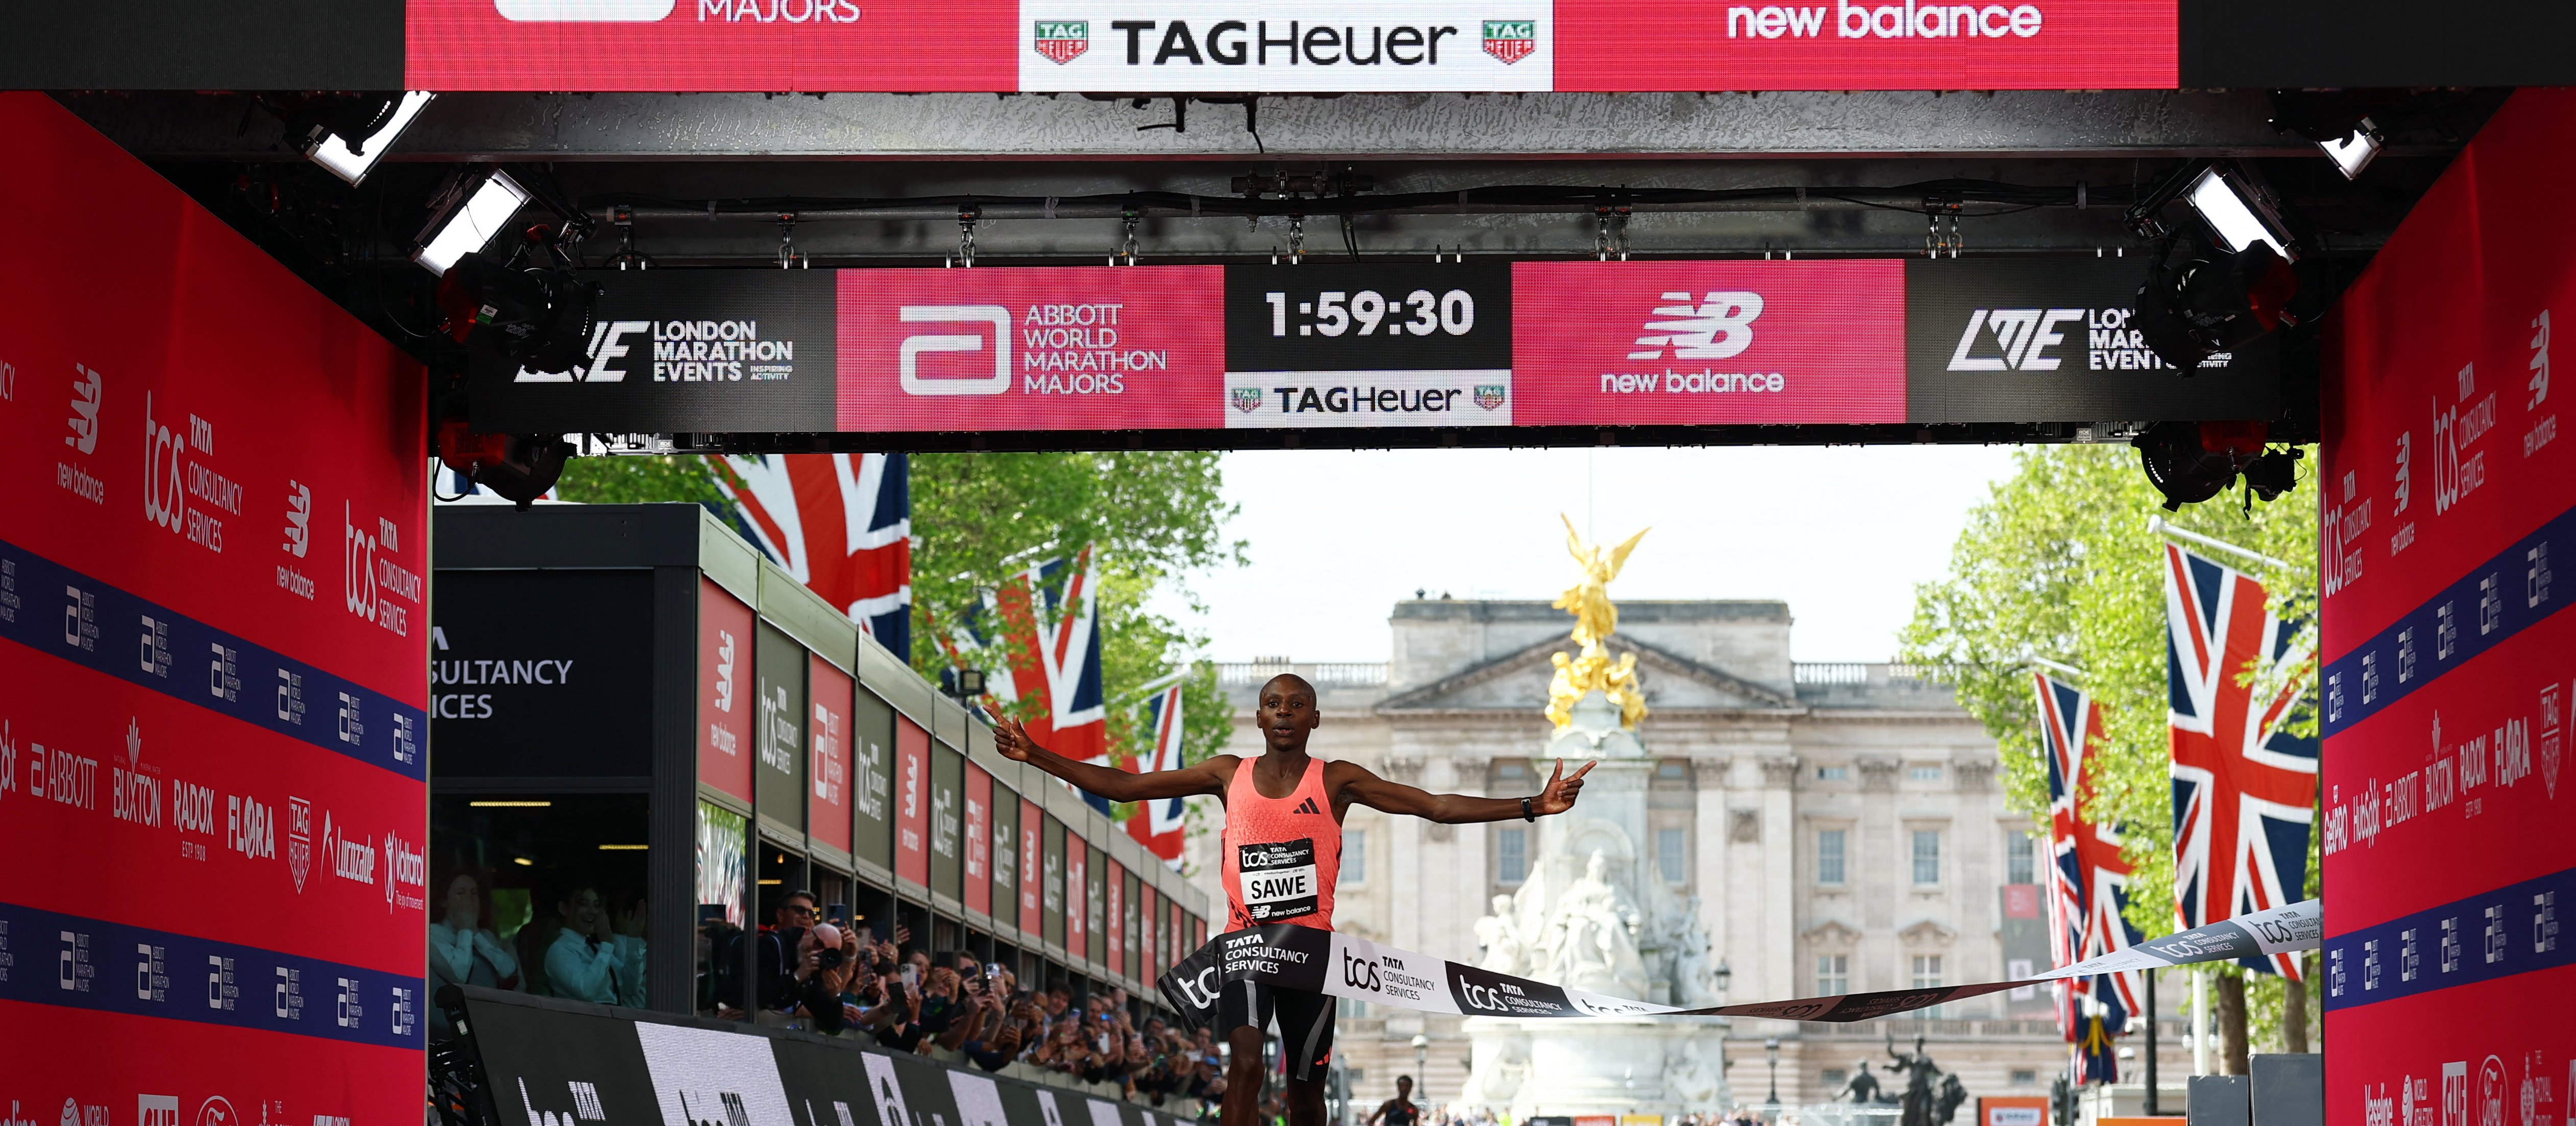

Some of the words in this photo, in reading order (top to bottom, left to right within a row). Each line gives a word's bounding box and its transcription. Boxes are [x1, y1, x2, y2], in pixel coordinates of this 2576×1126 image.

[696, 0, 861, 23] MAJORS
[1727, 4, 1826, 39] new
[1838, 0, 2043, 38] balance
[1038, 23, 1084, 39] TAG
[1486, 23, 1533, 38] TAG
[1037, 40, 1087, 63] HEUER
[1485, 39, 1533, 62] HEUER
[1024, 303, 1124, 326] ABBOTT
[1266, 289, 1475, 337] 1:59:30
[653, 321, 756, 341] LONDON
[1024, 327, 1117, 349] WORLD
[653, 341, 793, 361] MARATHON
[1024, 350, 1168, 372] MARATHON
[653, 361, 743, 382] EVENTS
[1601, 373, 1661, 394] new
[1666, 369, 1786, 393] balance
[2458, 361, 2475, 403] TATA
[1024, 373, 1125, 395] MAJORS
[2459, 390, 2497, 451] CONSULTANCY
[190, 412, 213, 456] TATA
[2523, 430, 2534, 459] new
[2535, 414, 2557, 451] balance
[144, 389, 184, 534] tcs
[2433, 395, 2459, 516] tcs
[57, 461, 74, 488] new
[74, 462, 104, 505] balance
[2461, 450, 2484, 499] SERVICES
[188, 460, 242, 517] CONSULTANCY
[2344, 469, 2356, 504] TATA
[187, 507, 222, 553] SERVICES
[2344, 496, 2372, 546] CONSULTANCY
[379, 516, 398, 553] TATA
[2324, 492, 2343, 599] tcs
[1, 559, 15, 577] ABBOTT
[346, 498, 376, 622] tcs
[2345, 547, 2363, 587] SERVICES
[1, 576, 14, 592] WORLD
[277, 565, 289, 590] new
[290, 565, 314, 601] balance
[379, 557, 421, 604] CONSULTANCY
[1, 591, 20, 610] MARATHON
[82, 591, 94, 608] ABBOTT
[0, 606, 14, 623] MAJORS
[81, 607, 93, 622] WORLD
[379, 598, 406, 638] SERVICES
[81, 622, 99, 640] MARATHON
[156, 621, 167, 637] ABBOTT
[81, 636, 93, 652] MAJORS
[155, 635, 167, 650] WORLD
[155, 650, 172, 666] MARATHON
[155, 663, 167, 678] MAJORS
[761, 676, 776, 767] tcs
[2542, 692, 2558, 729] TAG
[113, 754, 126, 765] NATURAL
[2494, 716, 2532, 788] FLORA
[140, 763, 152, 773] MINERAL
[153, 766, 161, 775] WATER
[2460, 734, 2487, 796] RADOX
[47, 748, 98, 811] ABBOTT
[2425, 755, 2453, 813] BUXTON
[113, 767, 161, 829] BUXTON
[174, 779, 214, 836] RADOX
[2393, 771, 2418, 825] ABBOTT
[291, 803, 309, 835] TAG
[2353, 778, 2380, 849] HubSpot
[228, 794, 276, 860] FLORA
[2324, 803, 2348, 857] GetPRO
[195, 843, 206, 862] 1908
[289, 840, 309, 886] HEUER
[336, 825, 375, 885] Lucozade
[395, 836, 424, 887] Voltarol
[1242, 849, 1268, 868] tcs
[1271, 849, 1309, 859] CONSULTANCY
[1251, 875, 1306, 900] SAWE
[406, 892, 409, 907] of
[410, 896, 424, 911] movement
[1286, 906, 1311, 915] balance
[2279, 911, 2301, 920] TATA
[77, 933, 89, 948] ABBOTT
[1225, 933, 1265, 949] TATA
[2182, 932, 2207, 941] TATA
[2194, 932, 2240, 946] CONSULTANCY
[2248, 920, 2293, 945] tcs
[2294, 929, 2320, 942] SERVICES
[76, 949, 88, 962] WORLD
[1225, 946, 1309, 965] CONSULTANCY
[2150, 940, 2203, 958] tcs
[2204, 942, 2234, 953] SERVICES
[76, 964, 94, 978] MARATHON
[1225, 960, 1279, 974] SERVICES
[1343, 946, 1381, 992] tcs
[1382, 956, 1405, 971] TATA
[76, 979, 89, 992] MAJORS
[1177, 953, 1221, 1010] tc
[1383, 970, 1435, 992] CONSULTANCY
[1386, 984, 1420, 1000] SERVICES
[1499, 982, 1525, 997] TATA
[1459, 974, 1509, 1012] tcs
[1504, 996, 1562, 1011] CONSULTANCY
[1511, 1006, 1553, 1015] SERVICES
[568, 1080, 606, 1121] TATA
[2414, 1078, 2427, 1101] WORLD
[84, 1105, 109, 1126] WORLD
